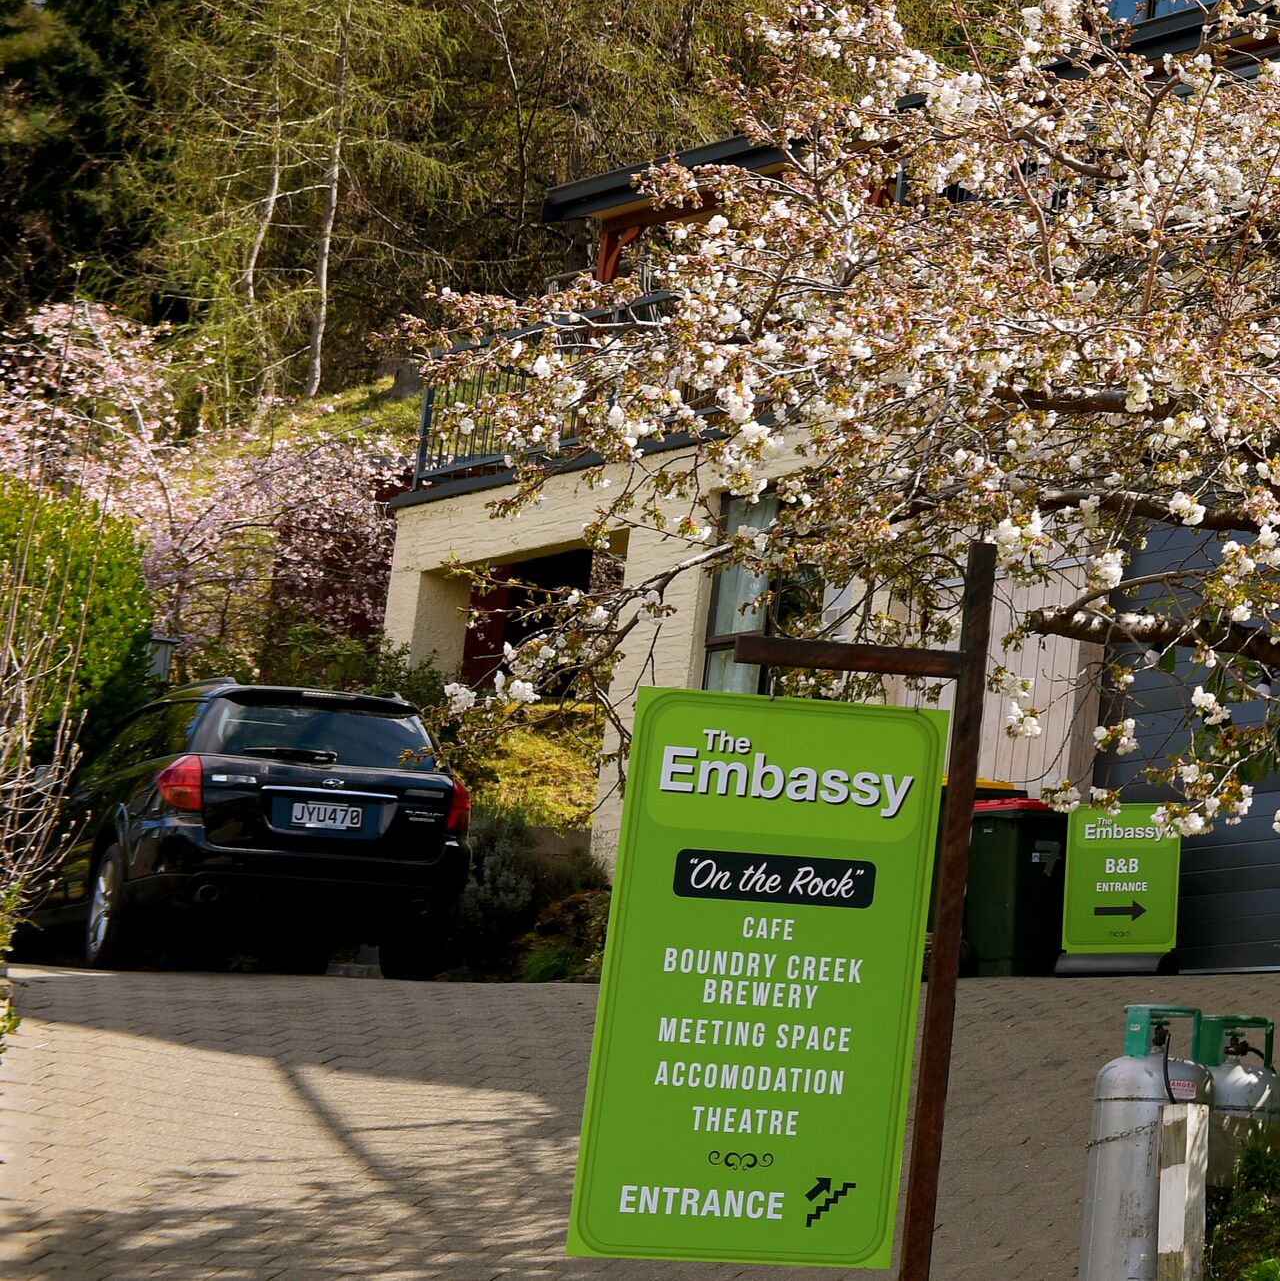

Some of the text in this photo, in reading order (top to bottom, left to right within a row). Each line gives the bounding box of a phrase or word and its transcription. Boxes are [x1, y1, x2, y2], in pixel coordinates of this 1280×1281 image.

[703, 729, 751, 754] The
[659, 745, 914, 818] Embassy
[294, 805, 362, 826] JYU470
[1097, 817, 1113, 825] The
[1084, 823, 1163, 842] Embassy
[738, 862, 782, 895] the
[1105, 858, 1139, 874] B&B
[1096, 881, 1148, 893] ENTRANCE
[742, 916, 795, 941] CAFE
[663, 948, 863, 984] BOUNDRY CREEK
[703, 980, 818, 1009] BREWERY
[658, 1018, 852, 1052] MEETING SPACE
[654, 1061, 845, 1095] ACCOMODATION
[692, 1106, 799, 1136] THEATRE
[619, 1185, 785, 1220] ENTRANCE
